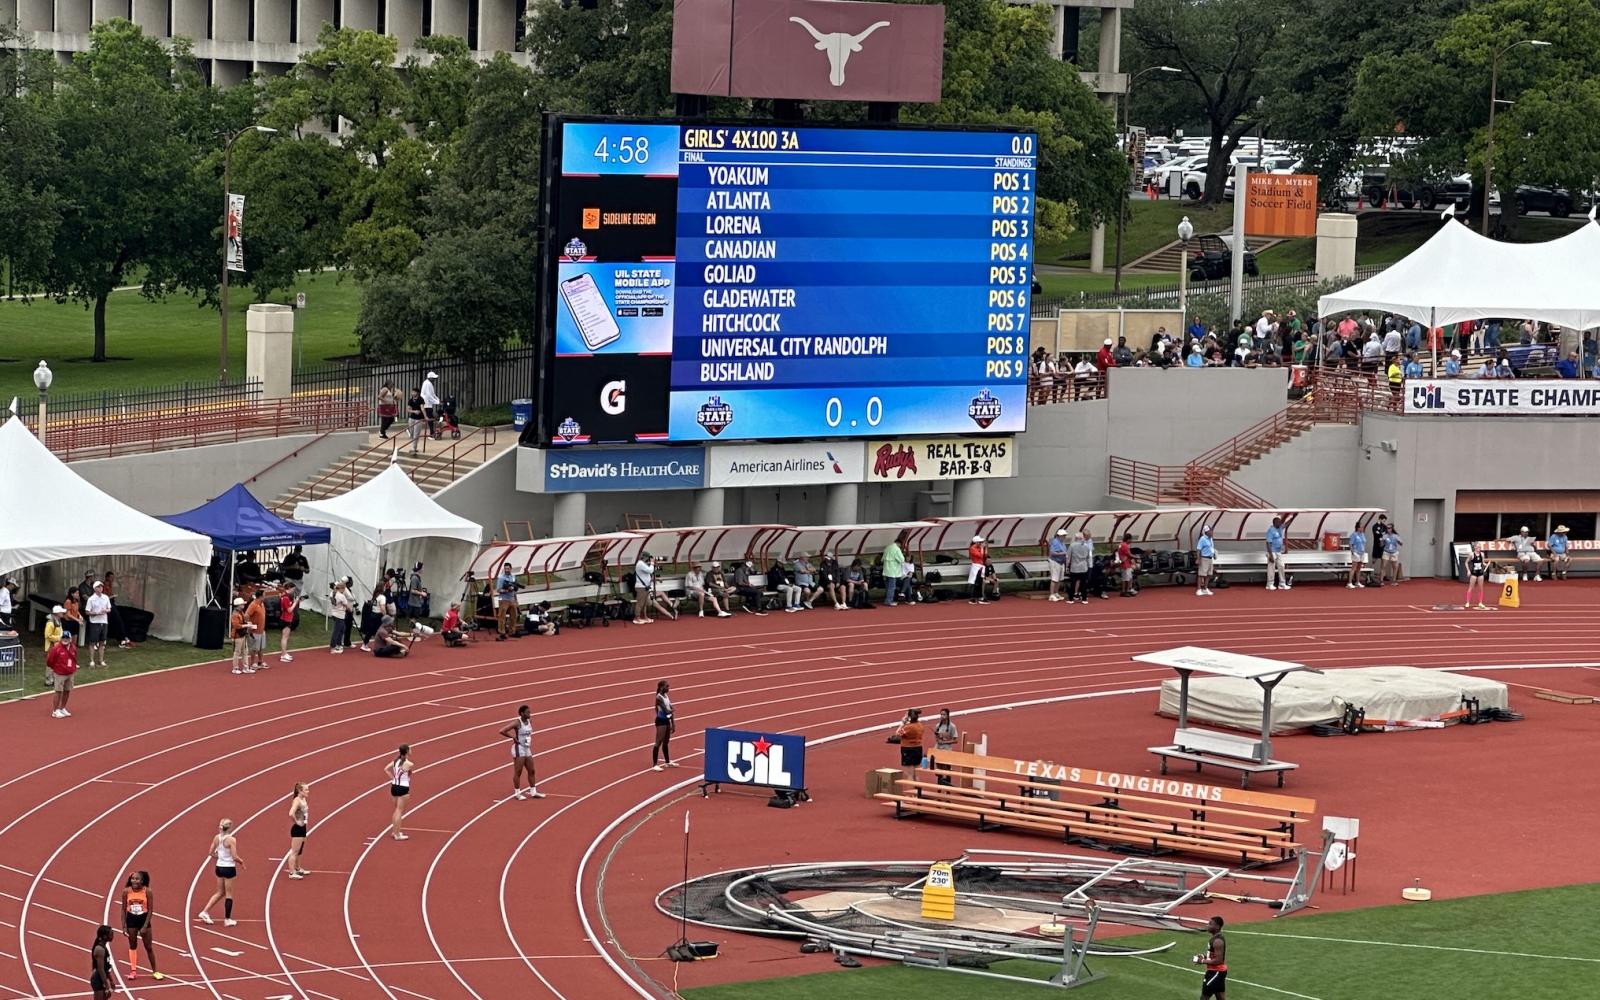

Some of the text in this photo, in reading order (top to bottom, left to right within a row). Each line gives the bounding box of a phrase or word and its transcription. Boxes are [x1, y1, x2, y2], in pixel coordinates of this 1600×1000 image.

[684, 129, 800, 150] GIRLS' 4X100 3A
[1011, 136, 1032, 154] 0.0
[594, 136, 649, 164] 4:58
[684, 152, 705, 162] FINAL
[994, 158, 1032, 168] STANDINGS
[708, 166, 768, 186] YOAKUM
[993, 172, 1030, 190] POS 1
[706, 191, 770, 210] ATLANTA
[1251, 186, 1304, 197] Stadium &
[992, 196, 1029, 214] POS 2
[1250, 198, 1312, 209] Soccer Field
[603, 212, 656, 225] SIDELINE DESIGN
[706, 216, 762, 234] LORENA
[992, 220, 1028, 237] POS 3
[705, 240, 776, 259] CANADIAN
[991, 243, 1028, 260] POS 4
[614, 269, 662, 278] UIL STATE
[704, 265, 756, 284] GOLIAD
[990, 266, 1026, 284] POS 5
[614, 279, 671, 287] MOBILE APP
[703, 289, 796, 308] GLADEWATER
[989, 290, 1026, 307] POS 6
[702, 314, 781, 332] HITCHCOCK
[988, 314, 1025, 331] POS 7
[702, 336, 887, 357] UNIVERSAL CITY RANDOLPH
[987, 337, 1024, 354] POS 8
[700, 362, 775, 382] BUSHLAND
[986, 360, 1023, 378] POS 9
[600, 380, 626, 415] G
[1458, 389, 1519, 406] STATE
[698, 412, 732, 422] STATE
[970, 405, 1000, 415] STATE
[927, 442, 1006, 459] REAL TEXAS
[730, 458, 825, 473] American Airlines
[874, 444, 918, 478] Rudy's
[1506, 585, 1512, 597] 9
[1014, 760, 1223, 800] TEXAS LONGHORNS
